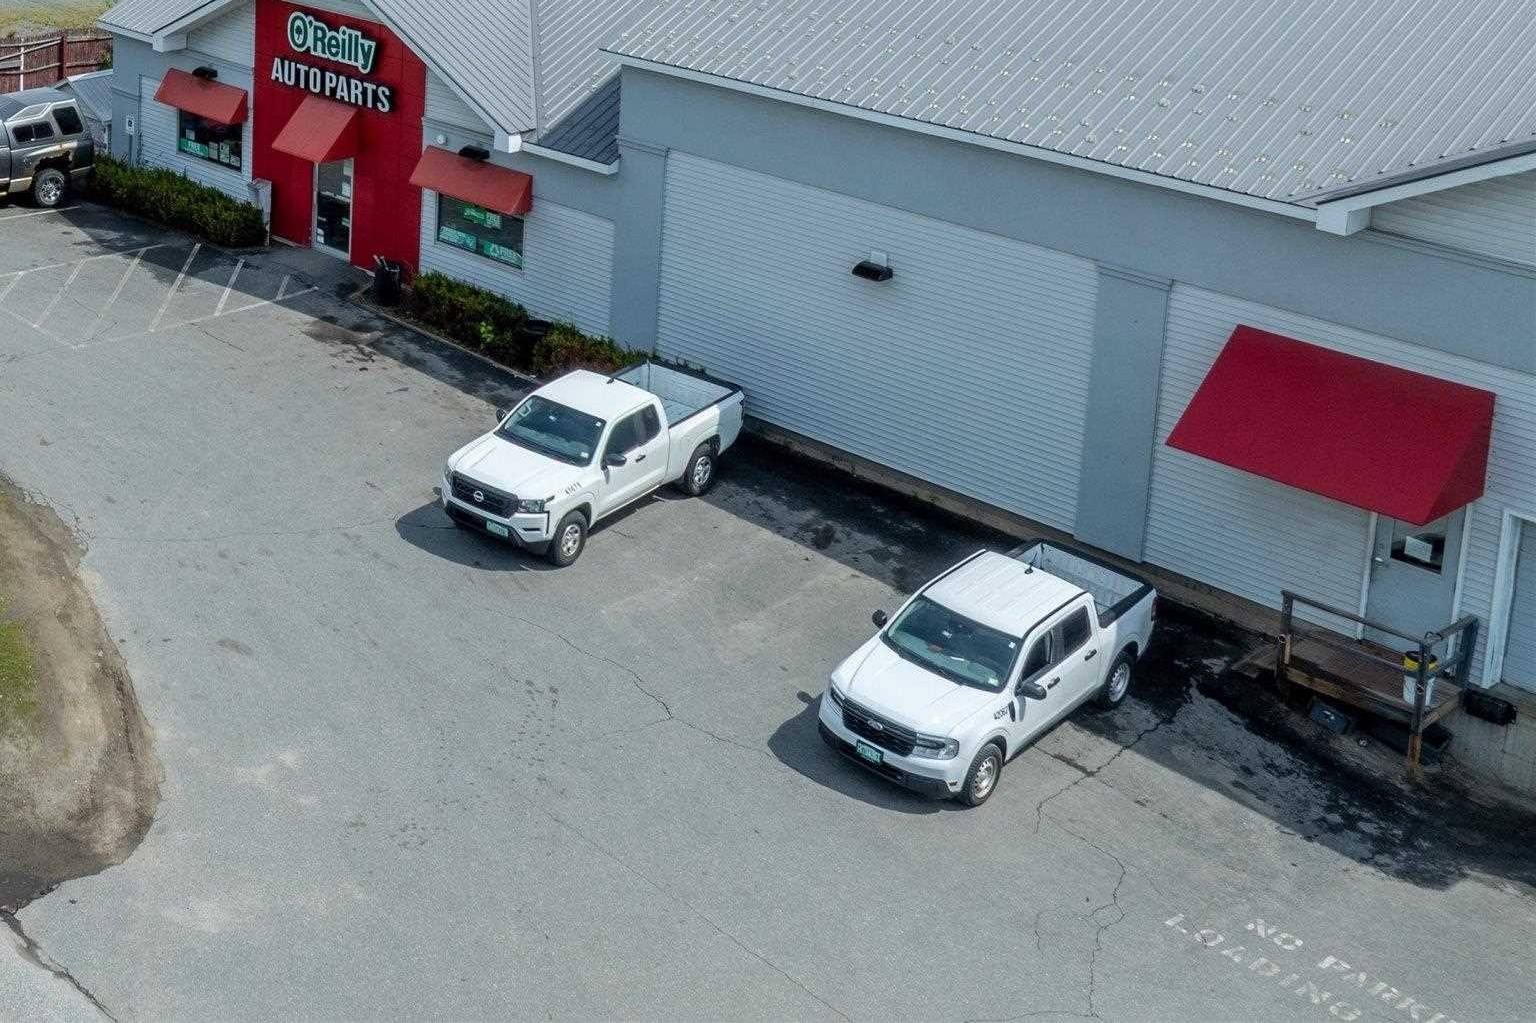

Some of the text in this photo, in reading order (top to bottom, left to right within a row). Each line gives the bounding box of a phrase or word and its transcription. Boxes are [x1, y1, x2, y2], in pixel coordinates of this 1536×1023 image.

[288, 12, 376, 73] O'Reilly
[271, 57, 391, 112] AUTO PARTS
[1245, 918, 1304, 951] NO
